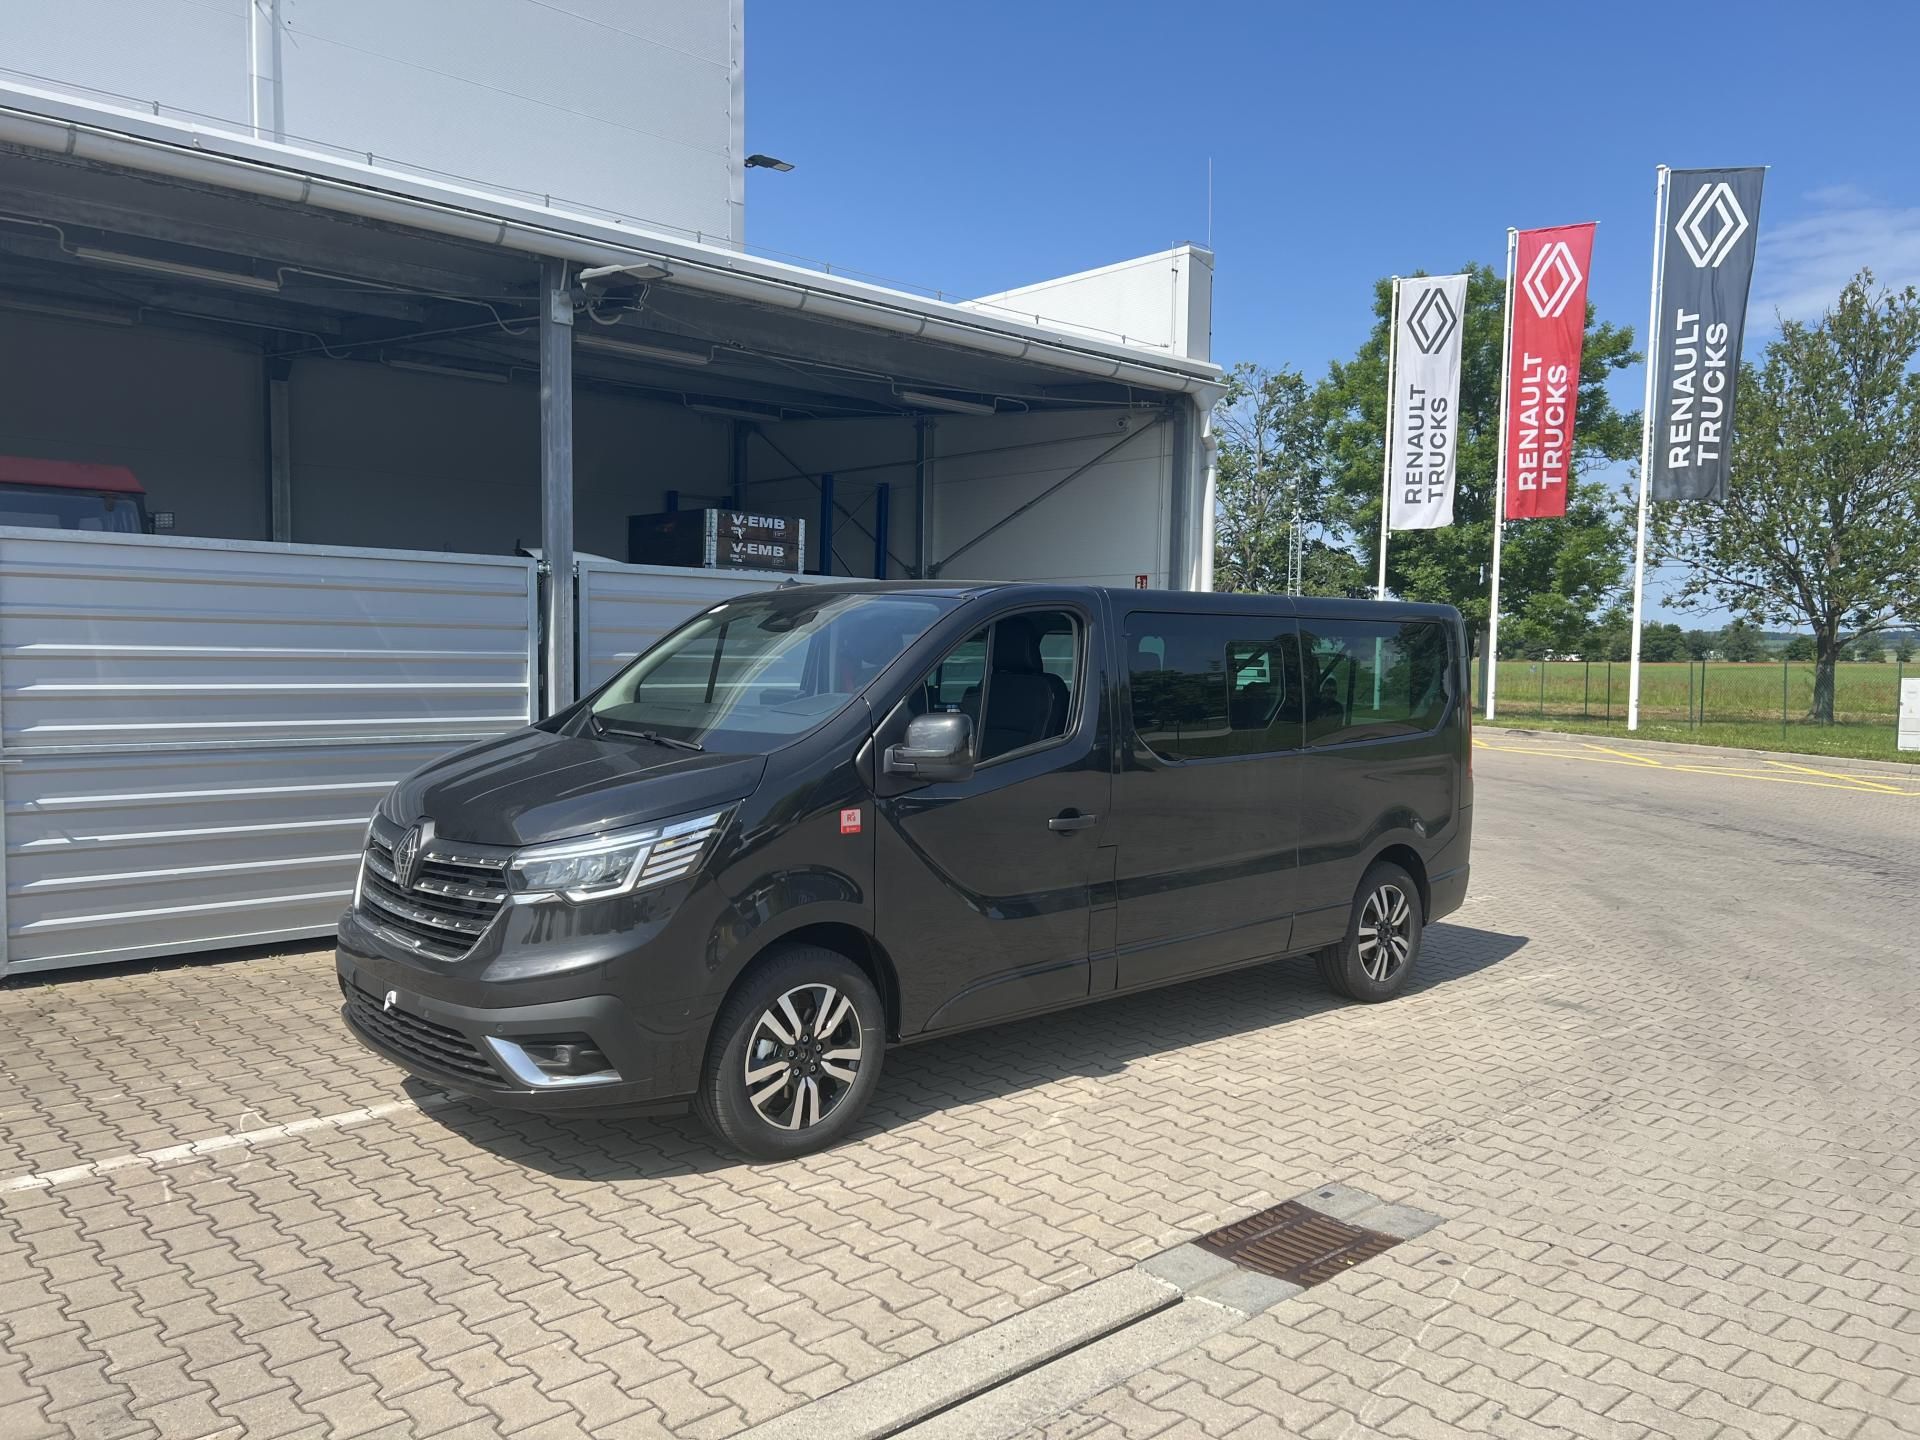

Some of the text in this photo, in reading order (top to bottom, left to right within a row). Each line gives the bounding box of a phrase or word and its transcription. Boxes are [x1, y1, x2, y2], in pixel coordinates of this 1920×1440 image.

[1405, 384, 1426, 505] RENAULT
[1427, 397, 1448, 503] TRUCKS
[1518, 352, 1542, 491] RENAULT
[1541, 364, 1568, 489] TRUCKS
[1669, 308, 1700, 469] RENAULT
[1697, 322, 1728, 466] TRUCKS
[731, 513, 786, 530] V-EMB
[731, 542, 785, 557] V-EMB
